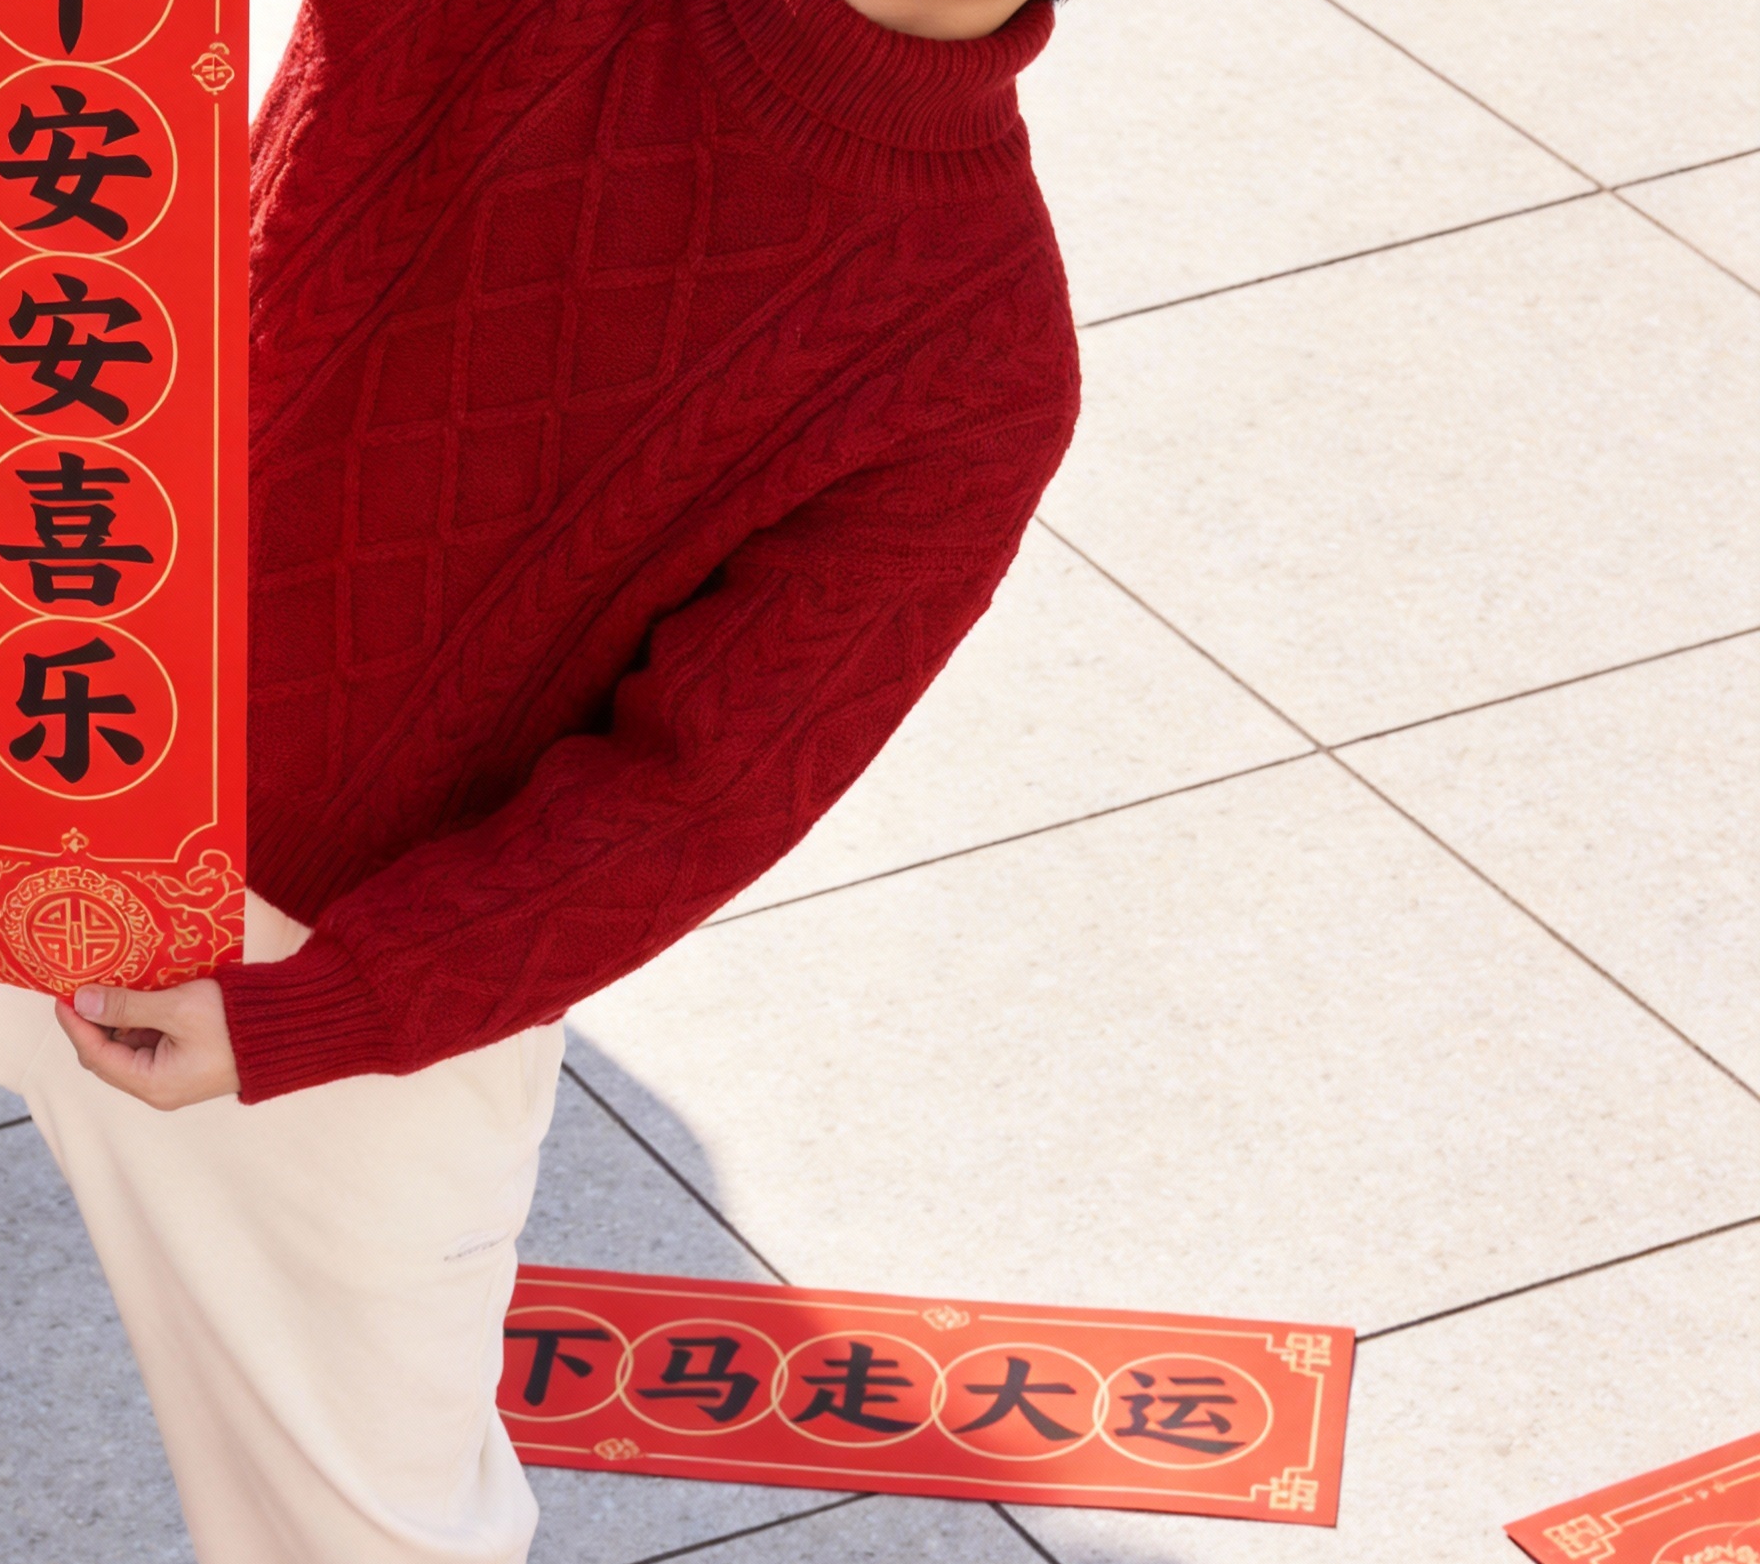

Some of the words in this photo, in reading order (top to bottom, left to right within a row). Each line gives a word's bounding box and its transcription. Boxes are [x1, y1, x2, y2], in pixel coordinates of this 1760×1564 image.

[502, 1326, 1246, 1455] 下马走大运
